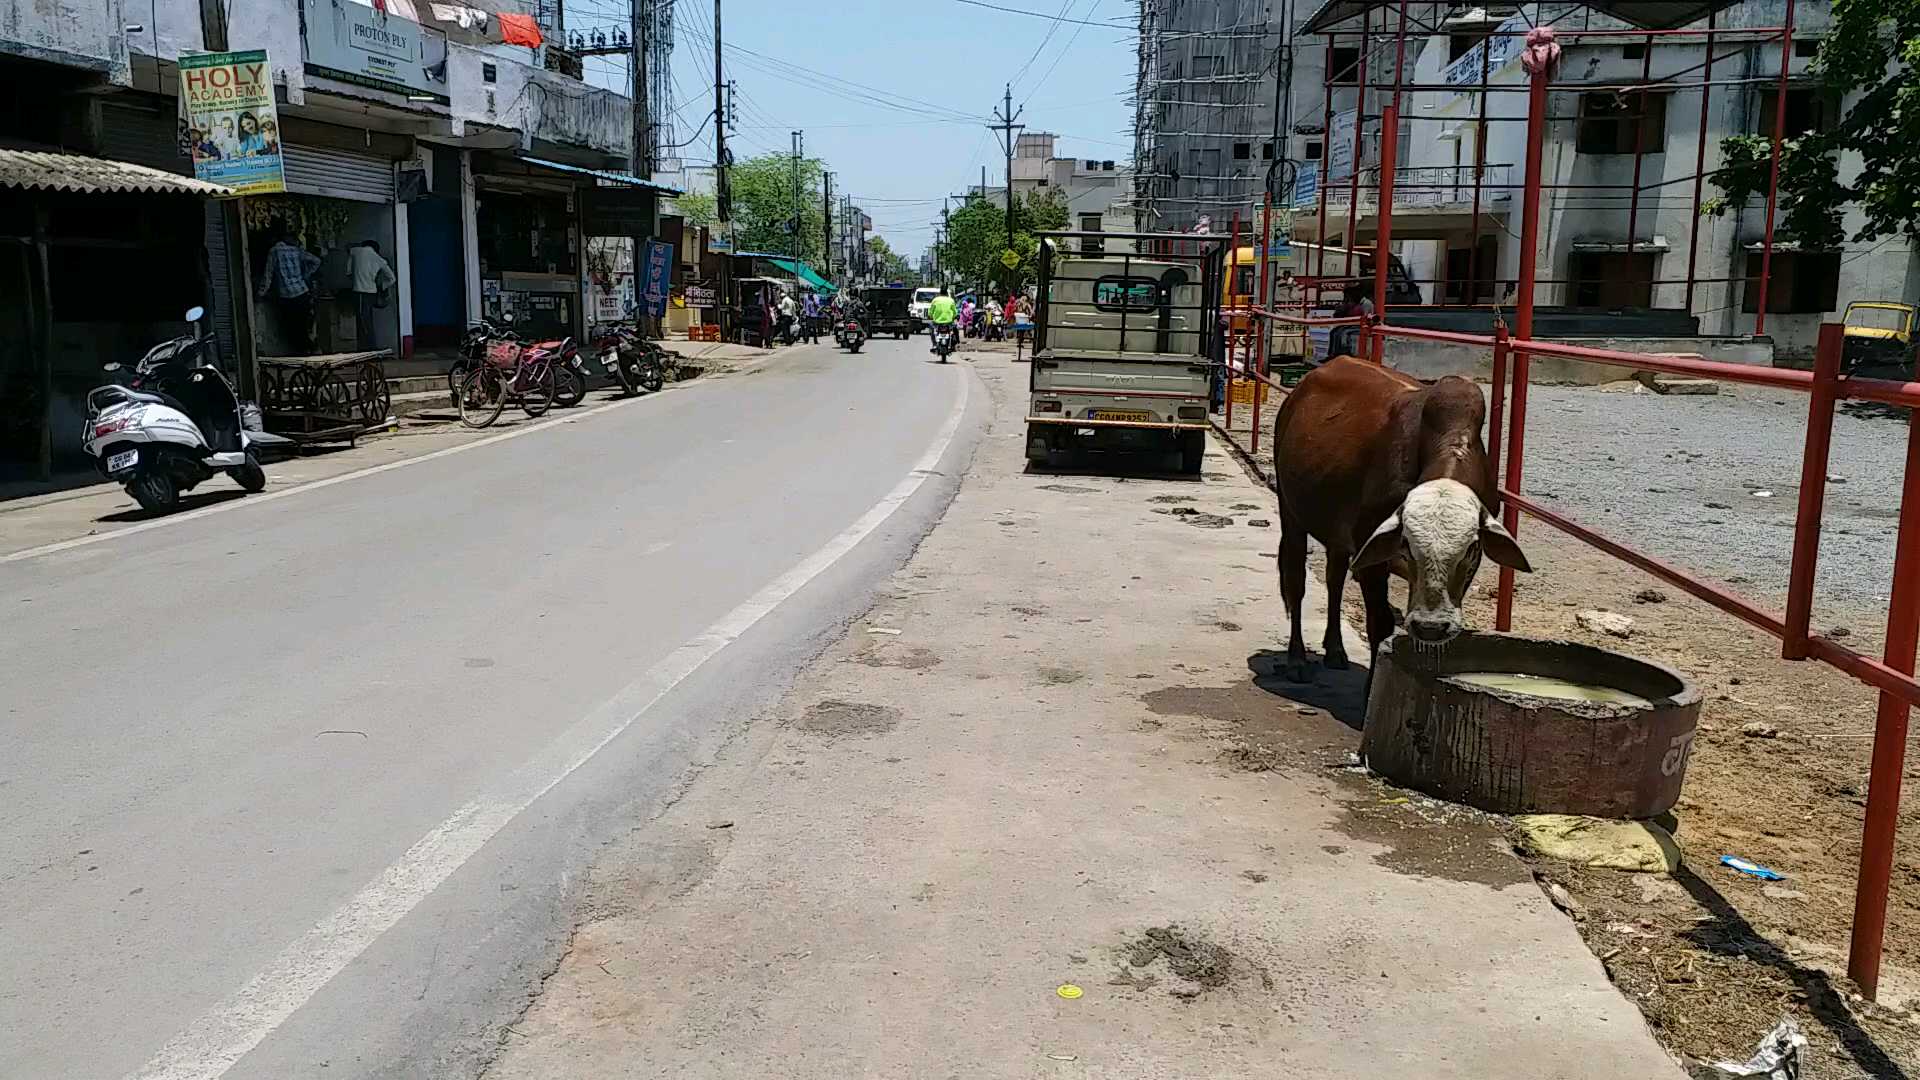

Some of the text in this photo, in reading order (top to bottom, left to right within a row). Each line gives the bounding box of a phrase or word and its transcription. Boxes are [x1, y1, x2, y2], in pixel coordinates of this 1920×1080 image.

[354, 24, 391, 43] PROTON
[392, 34, 407, 49] PLY
[186, 64, 264, 91] HOLY
[190, 84, 266, 102] ACADEMY
[600, 297, 618, 308] NEET
